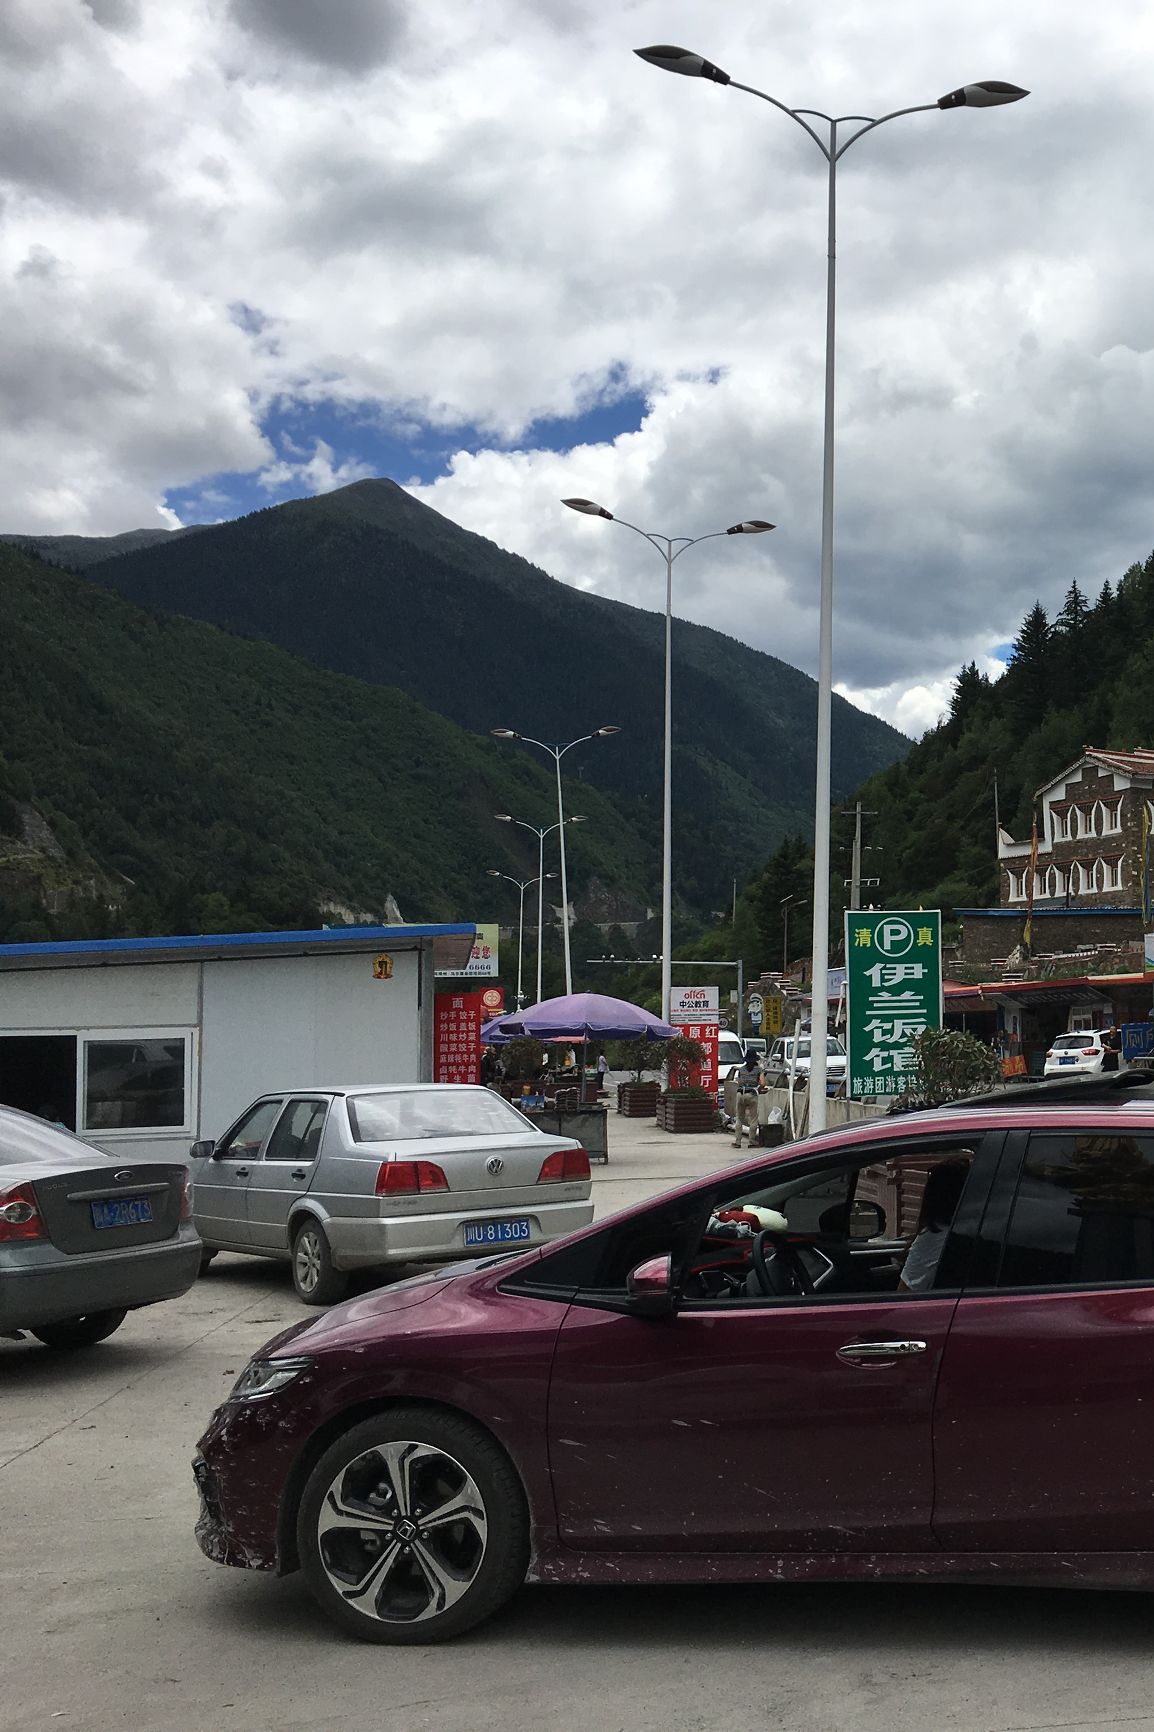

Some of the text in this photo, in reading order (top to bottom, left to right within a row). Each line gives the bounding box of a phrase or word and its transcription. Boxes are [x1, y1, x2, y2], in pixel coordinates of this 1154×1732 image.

[854, 924, 934, 950] 清 P 真
[680, 1000, 710, 1008] 中公教育
[863, 962, 929, 1073] 伊兰饭馆
